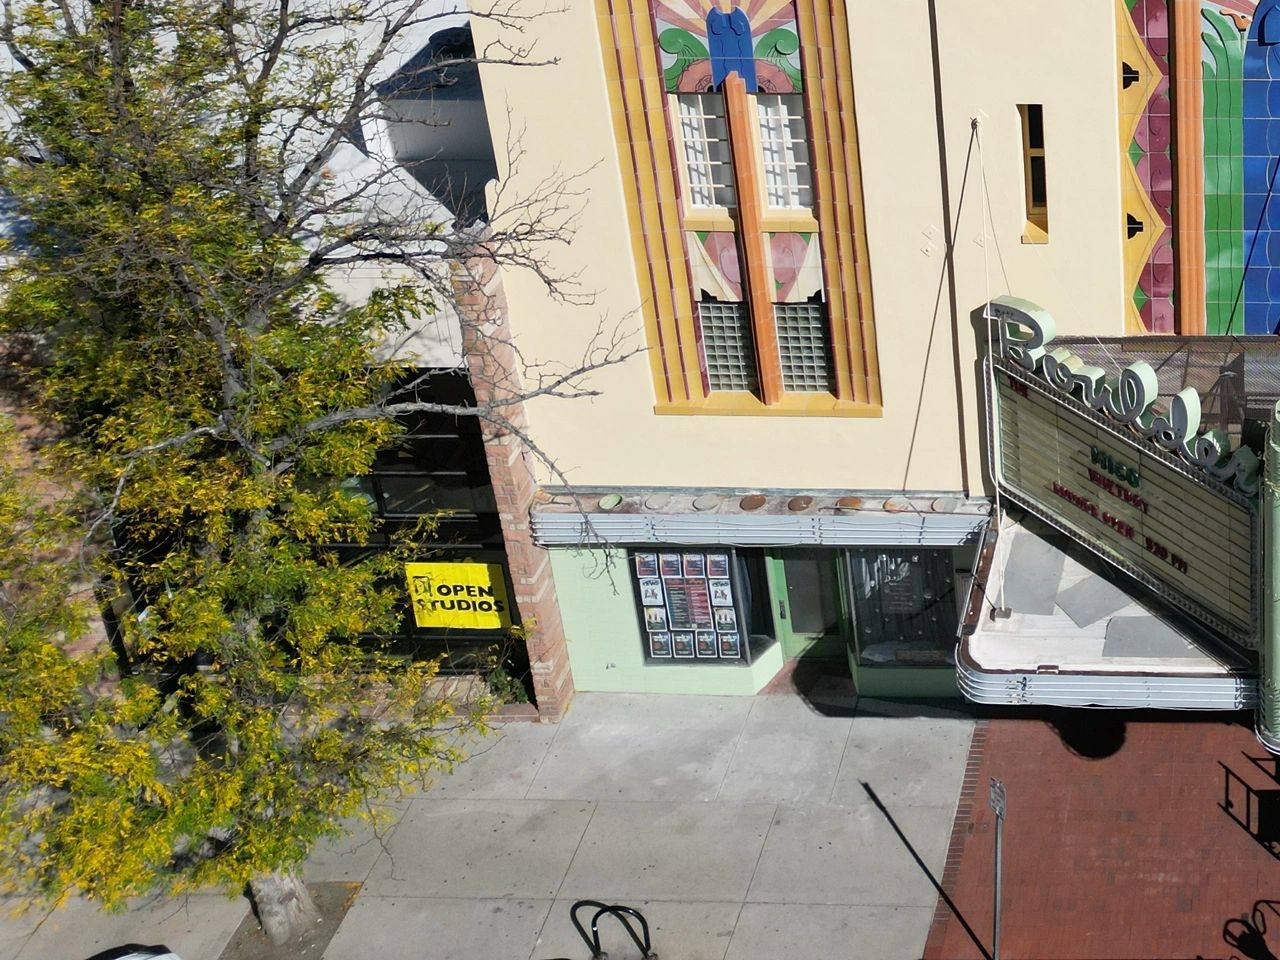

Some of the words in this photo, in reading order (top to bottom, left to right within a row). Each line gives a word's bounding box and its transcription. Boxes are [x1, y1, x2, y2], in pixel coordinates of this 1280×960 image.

[983, 295, 1260, 496] Boulder
[1102, 512, 1134, 540] OPEN
[436, 584, 495, 598] OPEN
